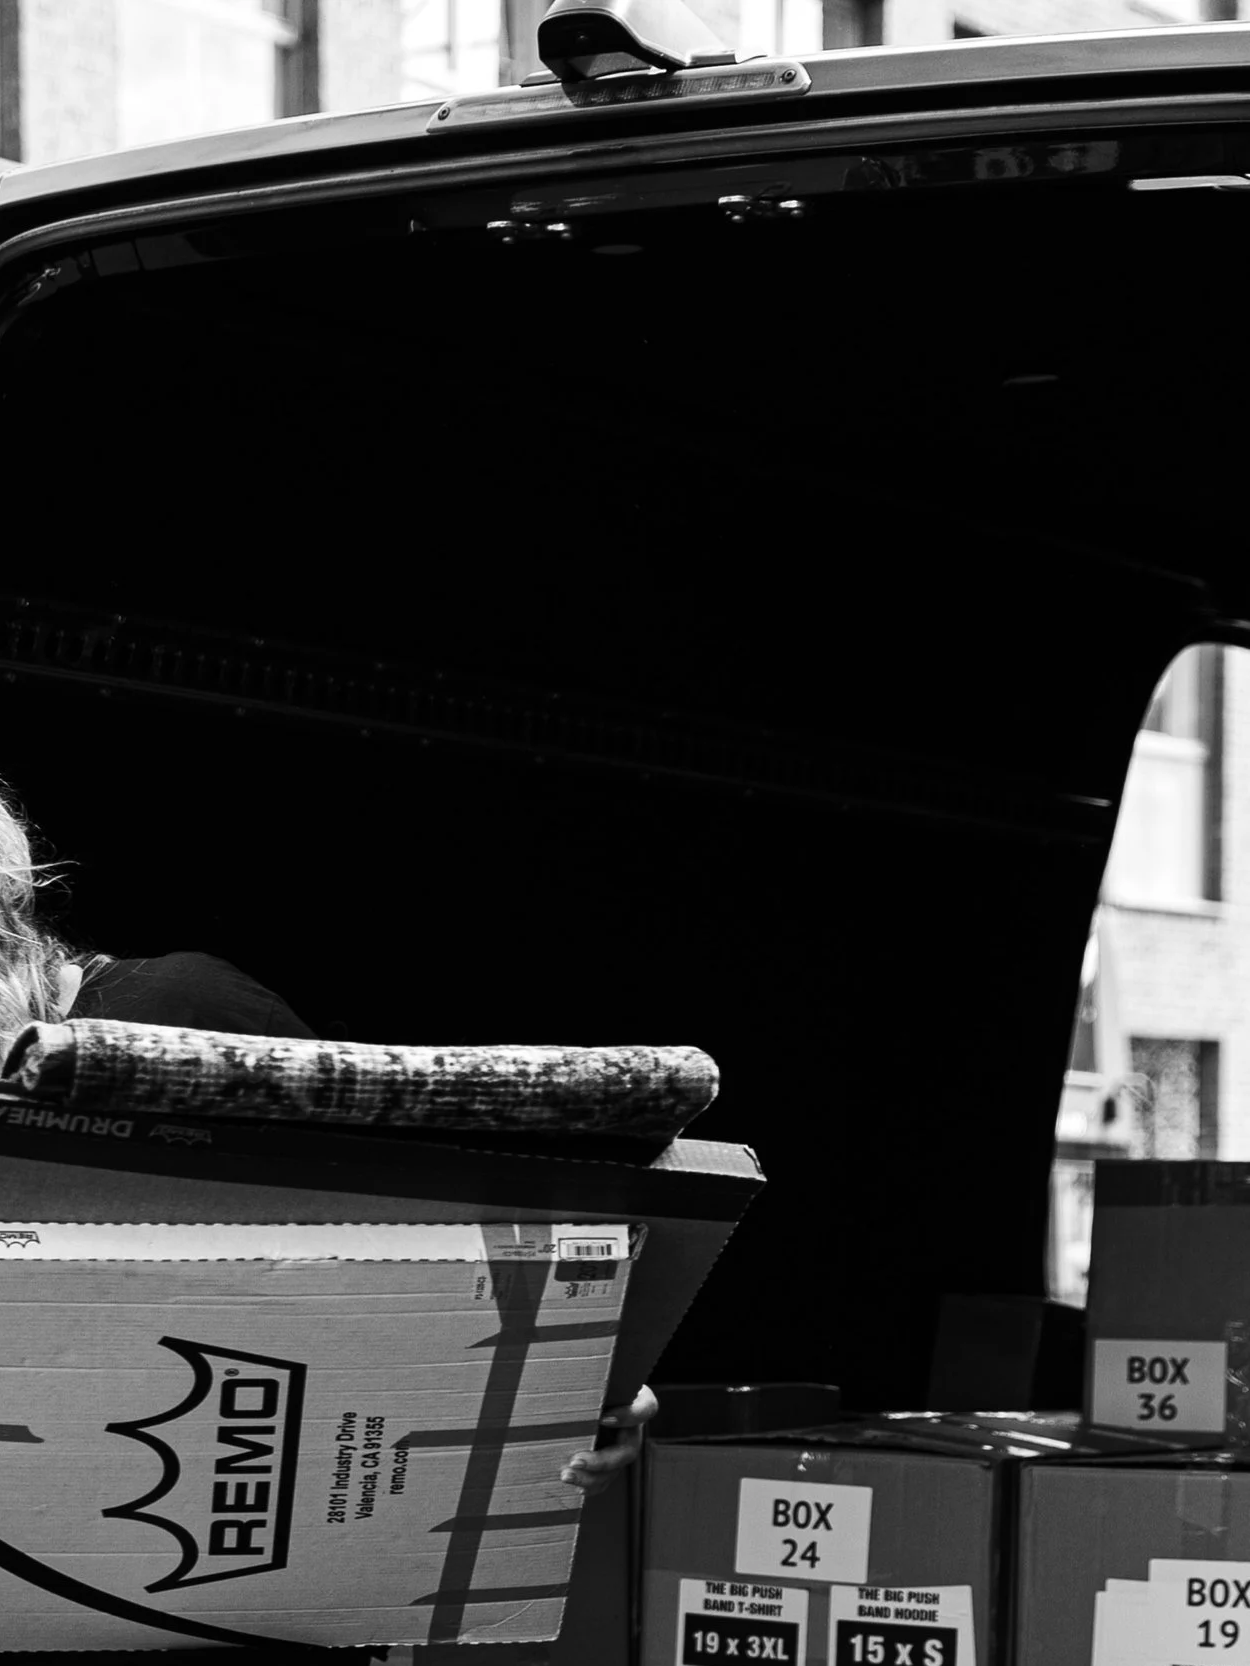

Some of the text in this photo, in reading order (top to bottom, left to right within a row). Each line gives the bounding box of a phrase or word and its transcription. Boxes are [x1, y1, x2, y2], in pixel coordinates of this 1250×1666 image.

[1126, 1356, 1190, 1385] BOX
[1137, 1393, 1178, 1421] 36
[208, 1378, 280, 1556] REMO
[327, 1411, 358, 1524] 28101 Industry Drive
[354, 1416, 385, 1520] Valencia, CA 91355
[772, 1498, 834, 1531] BOX
[781, 1538, 821, 1569] 24
[705, 1582, 783, 1600] THE BIG PUSH
[858, 1587, 940, 1605] THE BIG PUSH
[1187, 1577, 1250, 1609] BOX
[703, 1598, 783, 1617] BAND T-SHIRT
[857, 1604, 939, 1622] BAND HOODIE
[694, 1630, 789, 1660] 19 x 3XL
[1197, 1619, 1240, 1649] 19
[850, 1634, 885, 1664] 15
[895, 1642, 913, 1666] x
